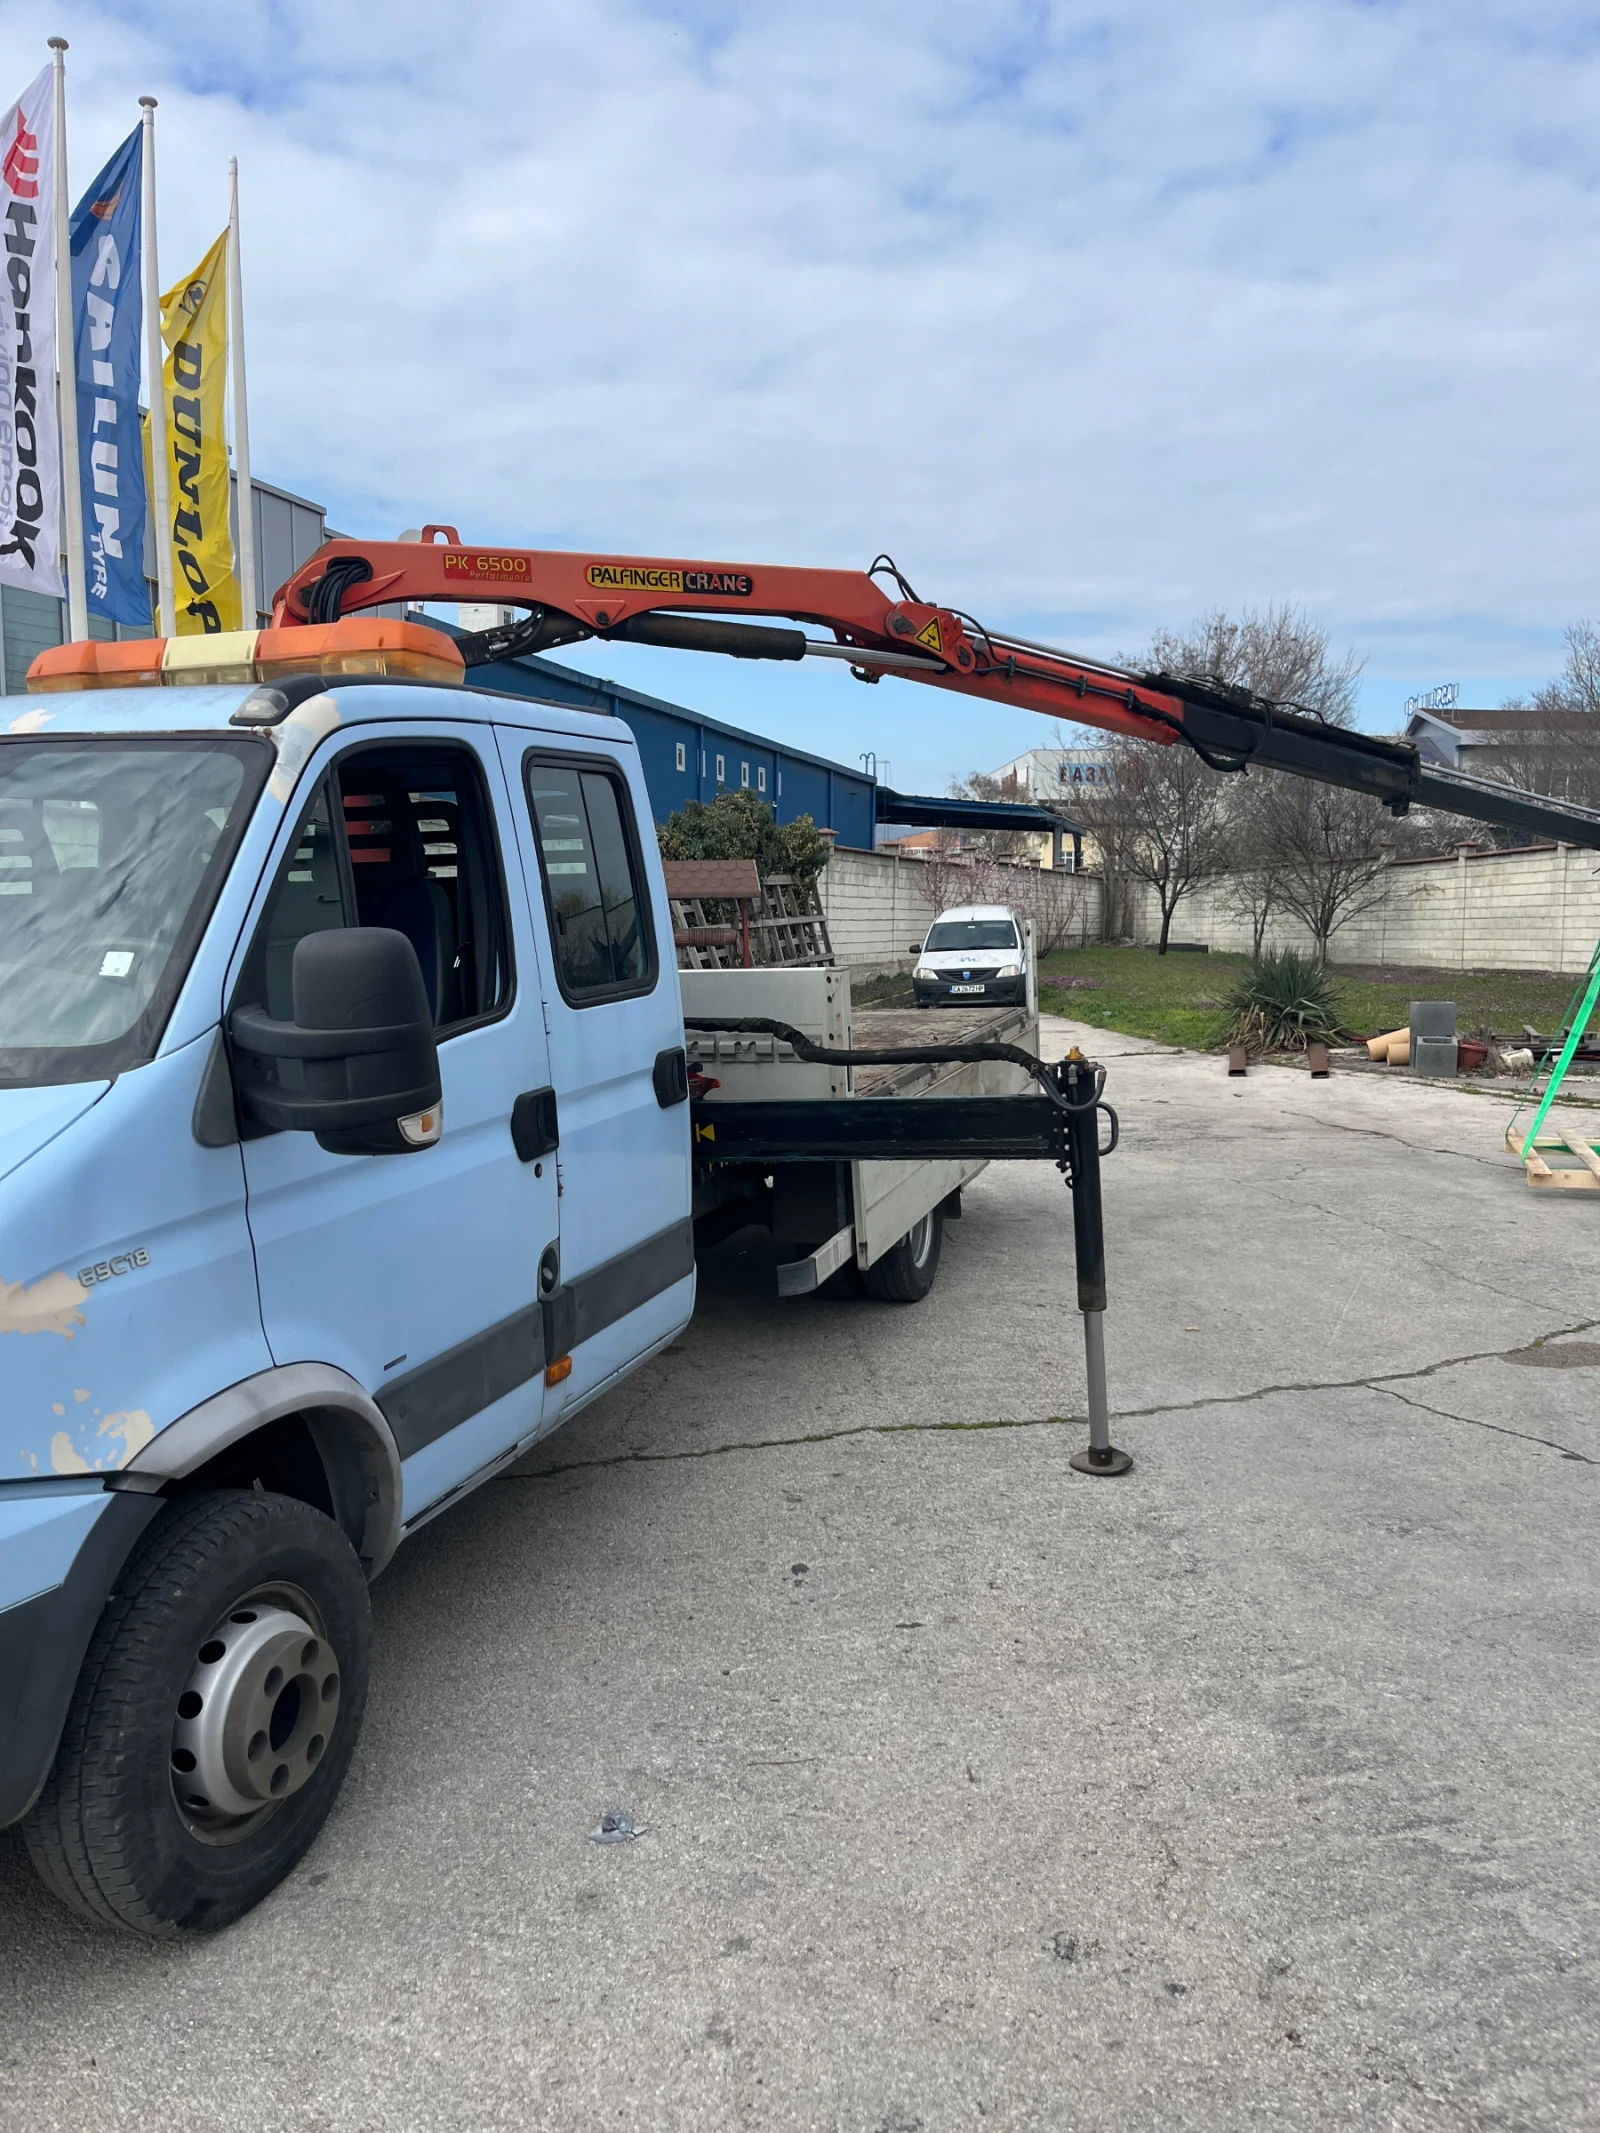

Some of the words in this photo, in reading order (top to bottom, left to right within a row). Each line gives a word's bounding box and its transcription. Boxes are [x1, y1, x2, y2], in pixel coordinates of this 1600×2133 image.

[87, 234, 123, 559] SAILUN
[173, 340, 222, 634] DUNLOP
[90, 532, 107, 599] TYRE
[444, 554, 469, 570] PK
[476, 556, 526, 572] 6500
[469, 570, 531, 582] Performance
[590, 566, 681, 588] PALFINGER
[685, 573, 747, 592] CRANE
[78, 1247, 151, 1287] 65C18
